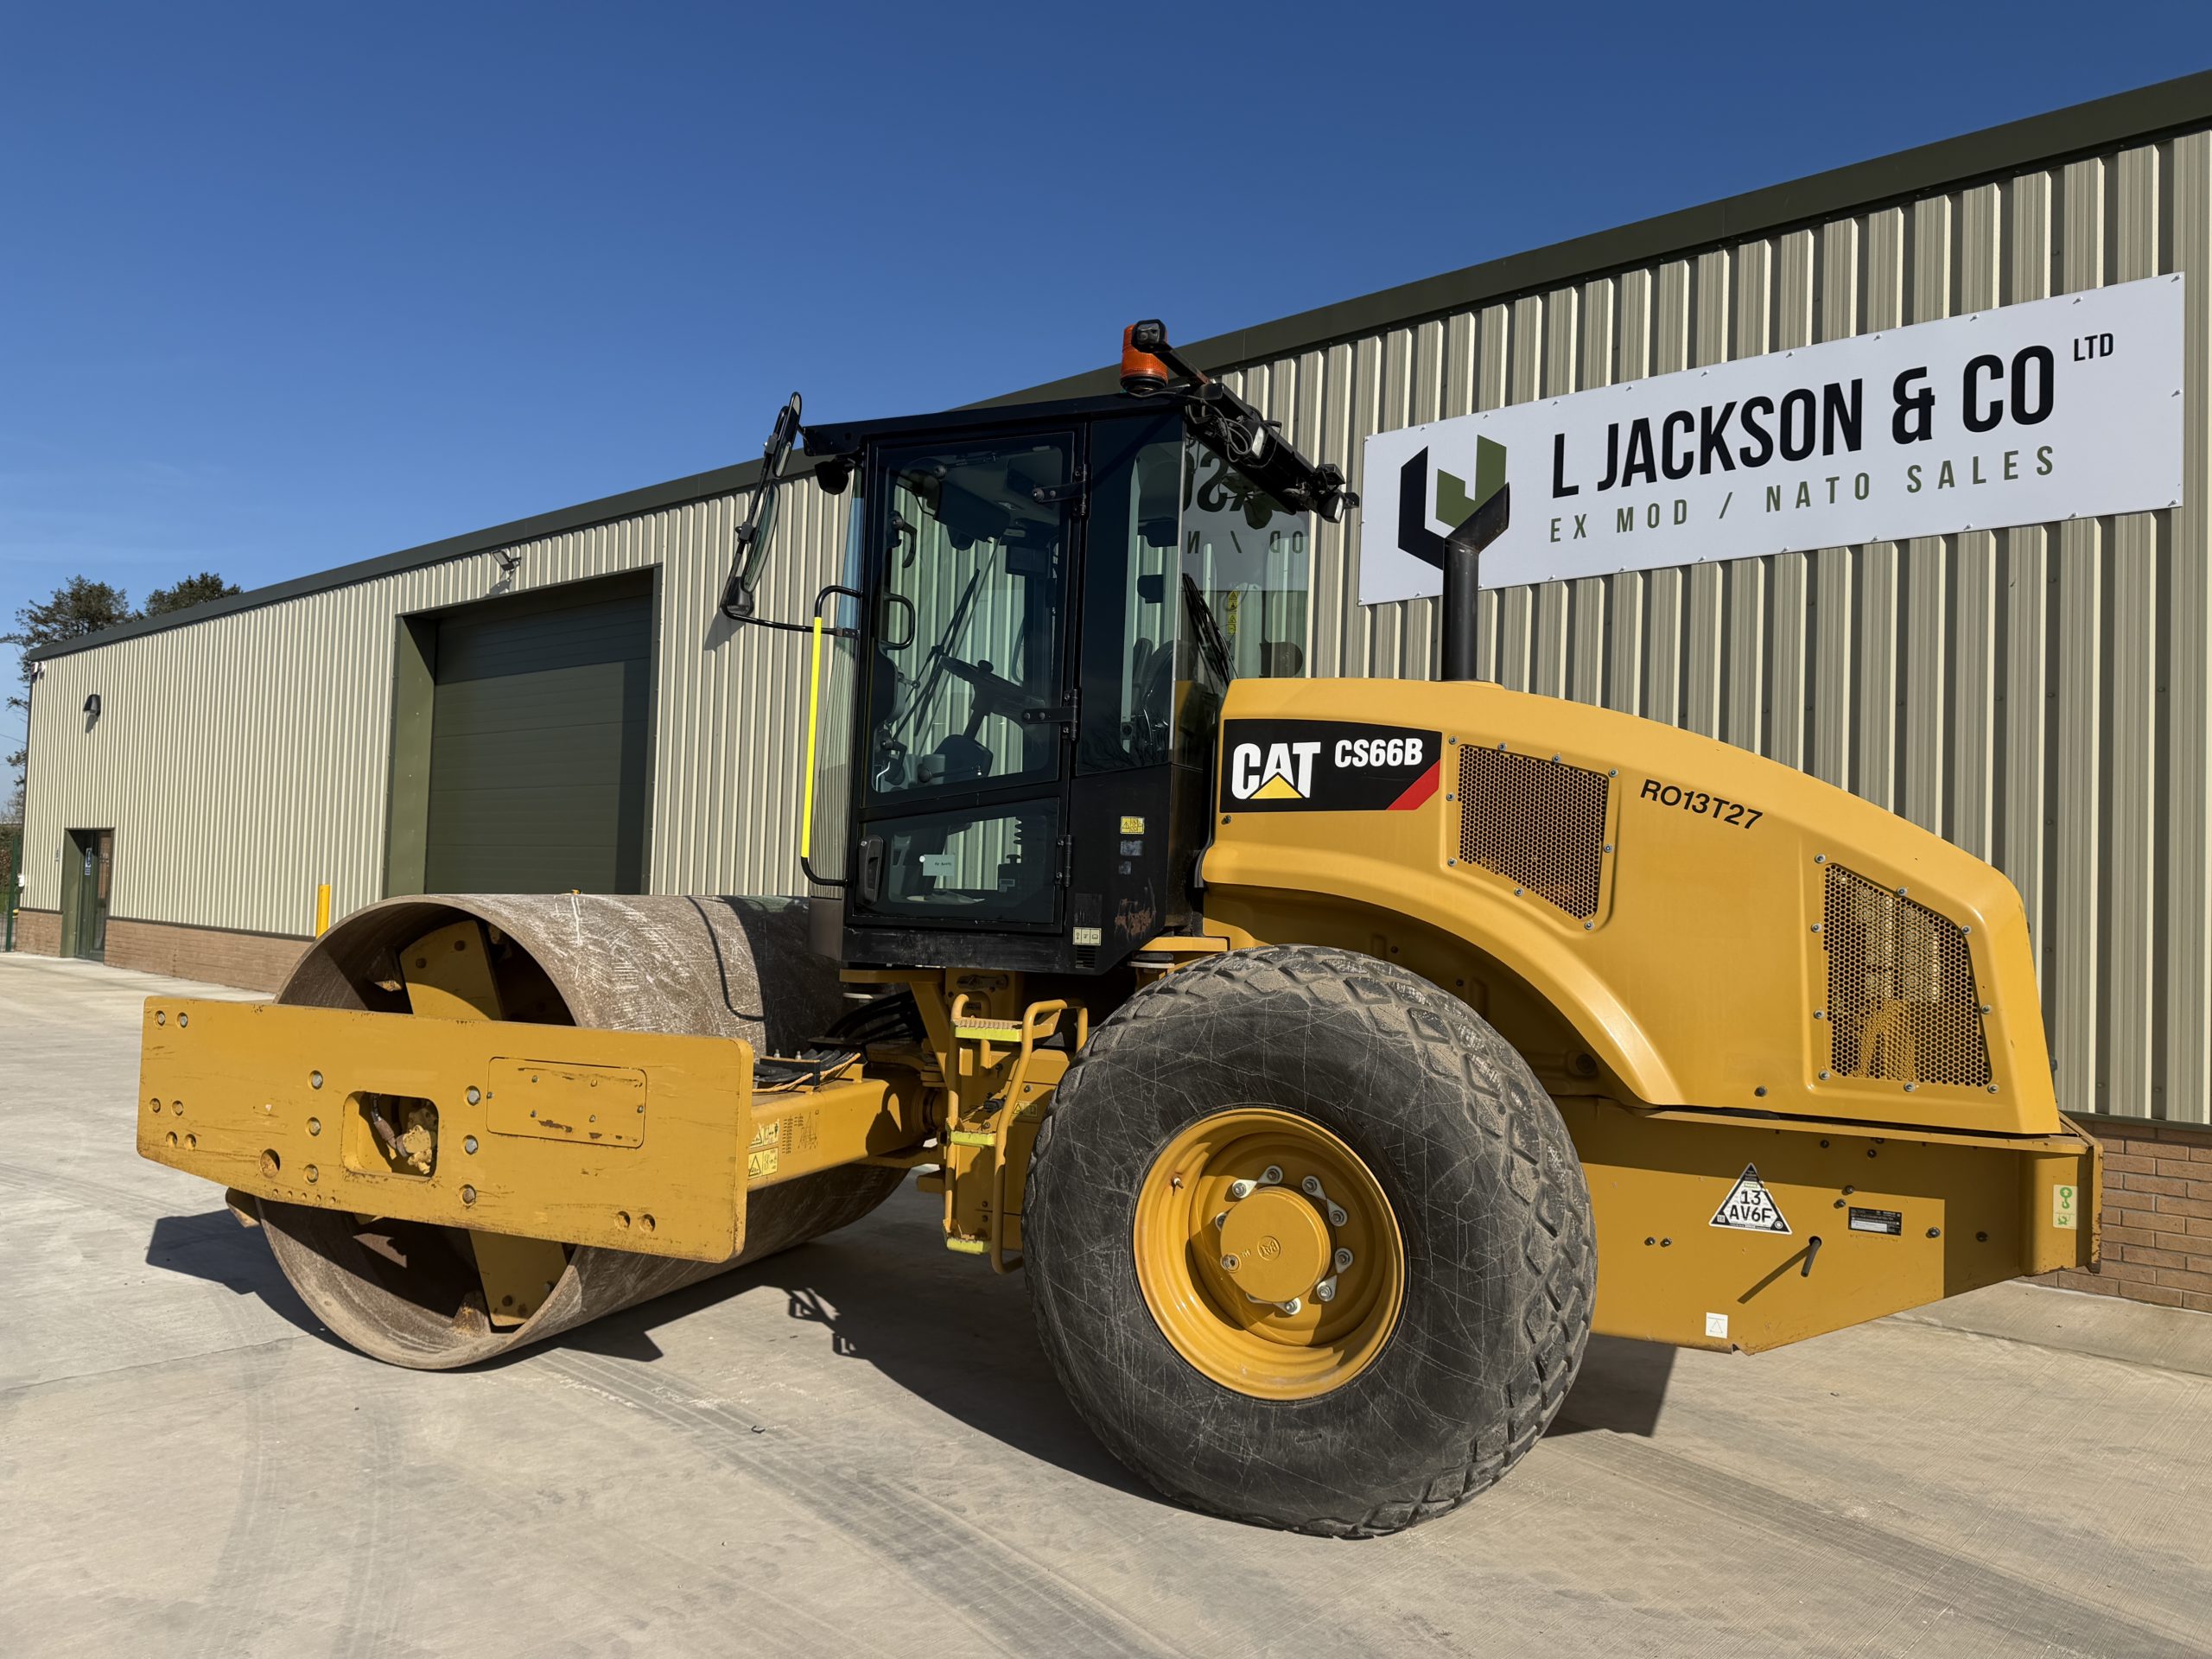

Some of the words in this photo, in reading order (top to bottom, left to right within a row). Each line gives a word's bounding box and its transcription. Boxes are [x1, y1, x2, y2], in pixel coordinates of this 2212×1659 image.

[1552, 432, 1580, 499] L
[1597, 377, 1863, 492] JACKSON
[1891, 365, 1936, 445] &
[1962, 345, 2055, 433] CO
[2073, 332, 2114, 362] LTD
[1549, 513, 1587, 543] EX
[1616, 498, 1688, 534] MOD
[1718, 491, 1733, 519] /
[1765, 471, 1871, 513] NATO
[1906, 445, 2054, 494] SALES
[1231, 741, 1322, 800] CAT
[1334, 738, 1424, 768] CS66B
[1640, 779, 1764, 830] RO13T27
[1729, 1205, 1773, 1224] AV6F
[1739, 1189, 1762, 1206] 13
